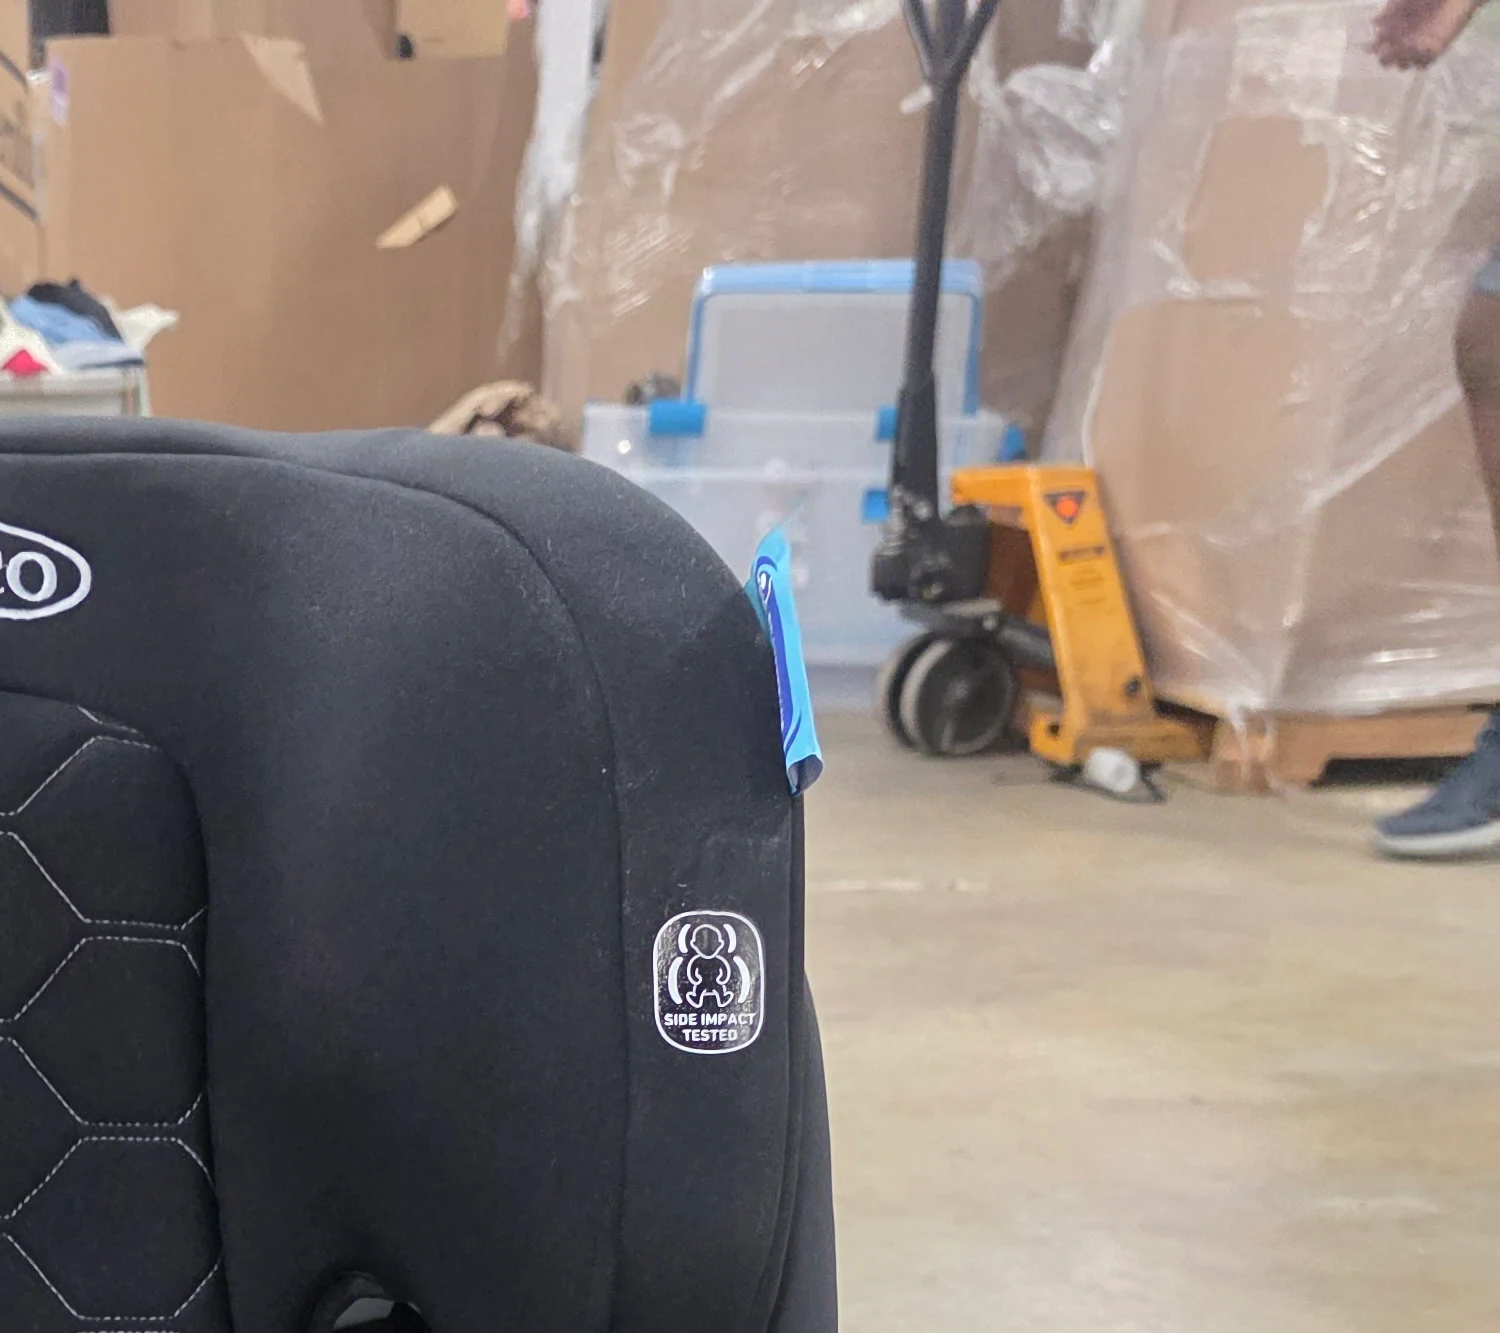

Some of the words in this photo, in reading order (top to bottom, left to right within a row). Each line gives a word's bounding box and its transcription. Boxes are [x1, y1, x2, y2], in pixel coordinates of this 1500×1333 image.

[664, 1013, 698, 1027] SIDE
[701, 1012, 757, 1027] IMPACT
[682, 1029, 738, 1042] TESTED
